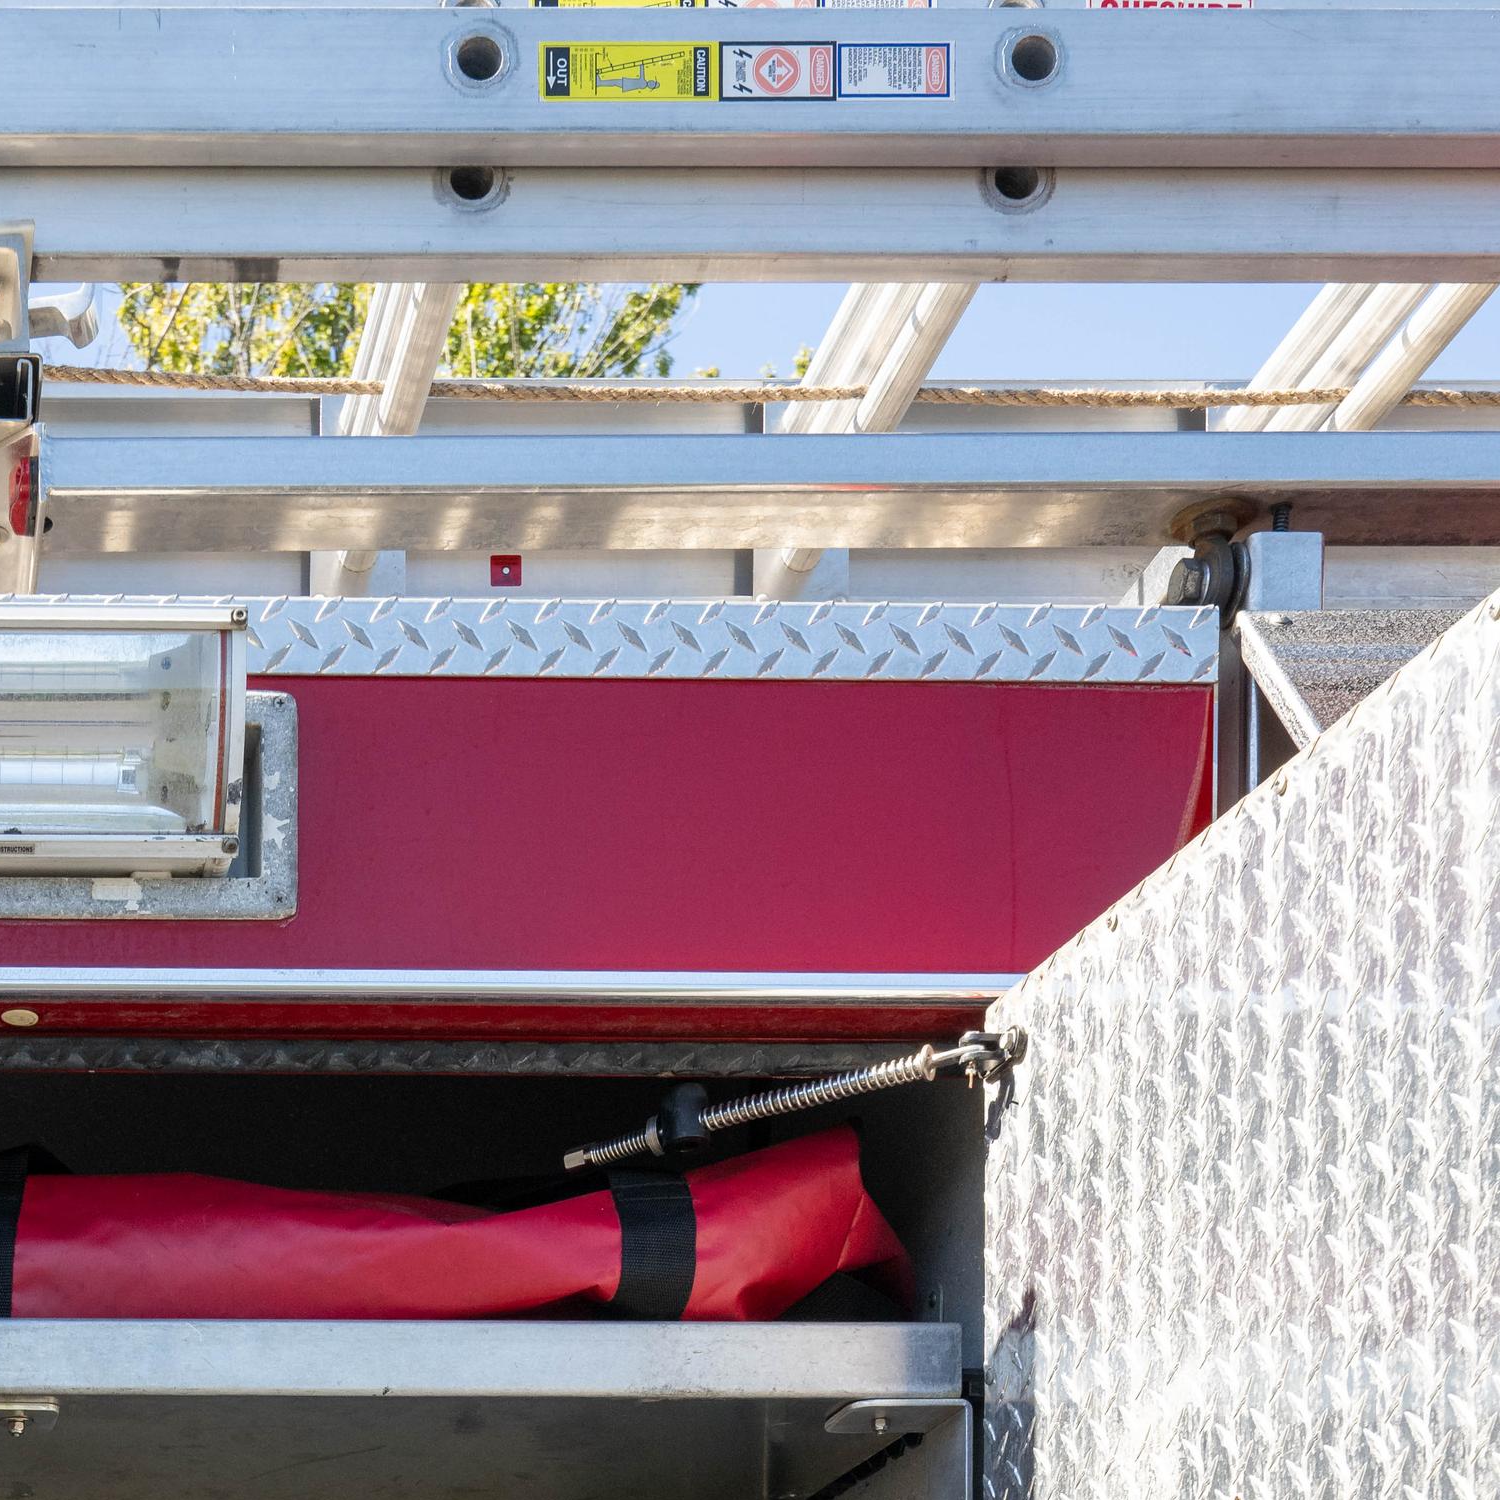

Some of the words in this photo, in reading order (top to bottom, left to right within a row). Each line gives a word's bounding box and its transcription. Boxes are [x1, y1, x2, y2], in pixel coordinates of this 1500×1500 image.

[556, 58, 567, 86] OUT
[696, 50, 706, 92] CAUTION
[816, 55, 825, 86] DANGER
[930, 55, 940, 84] DANGER
